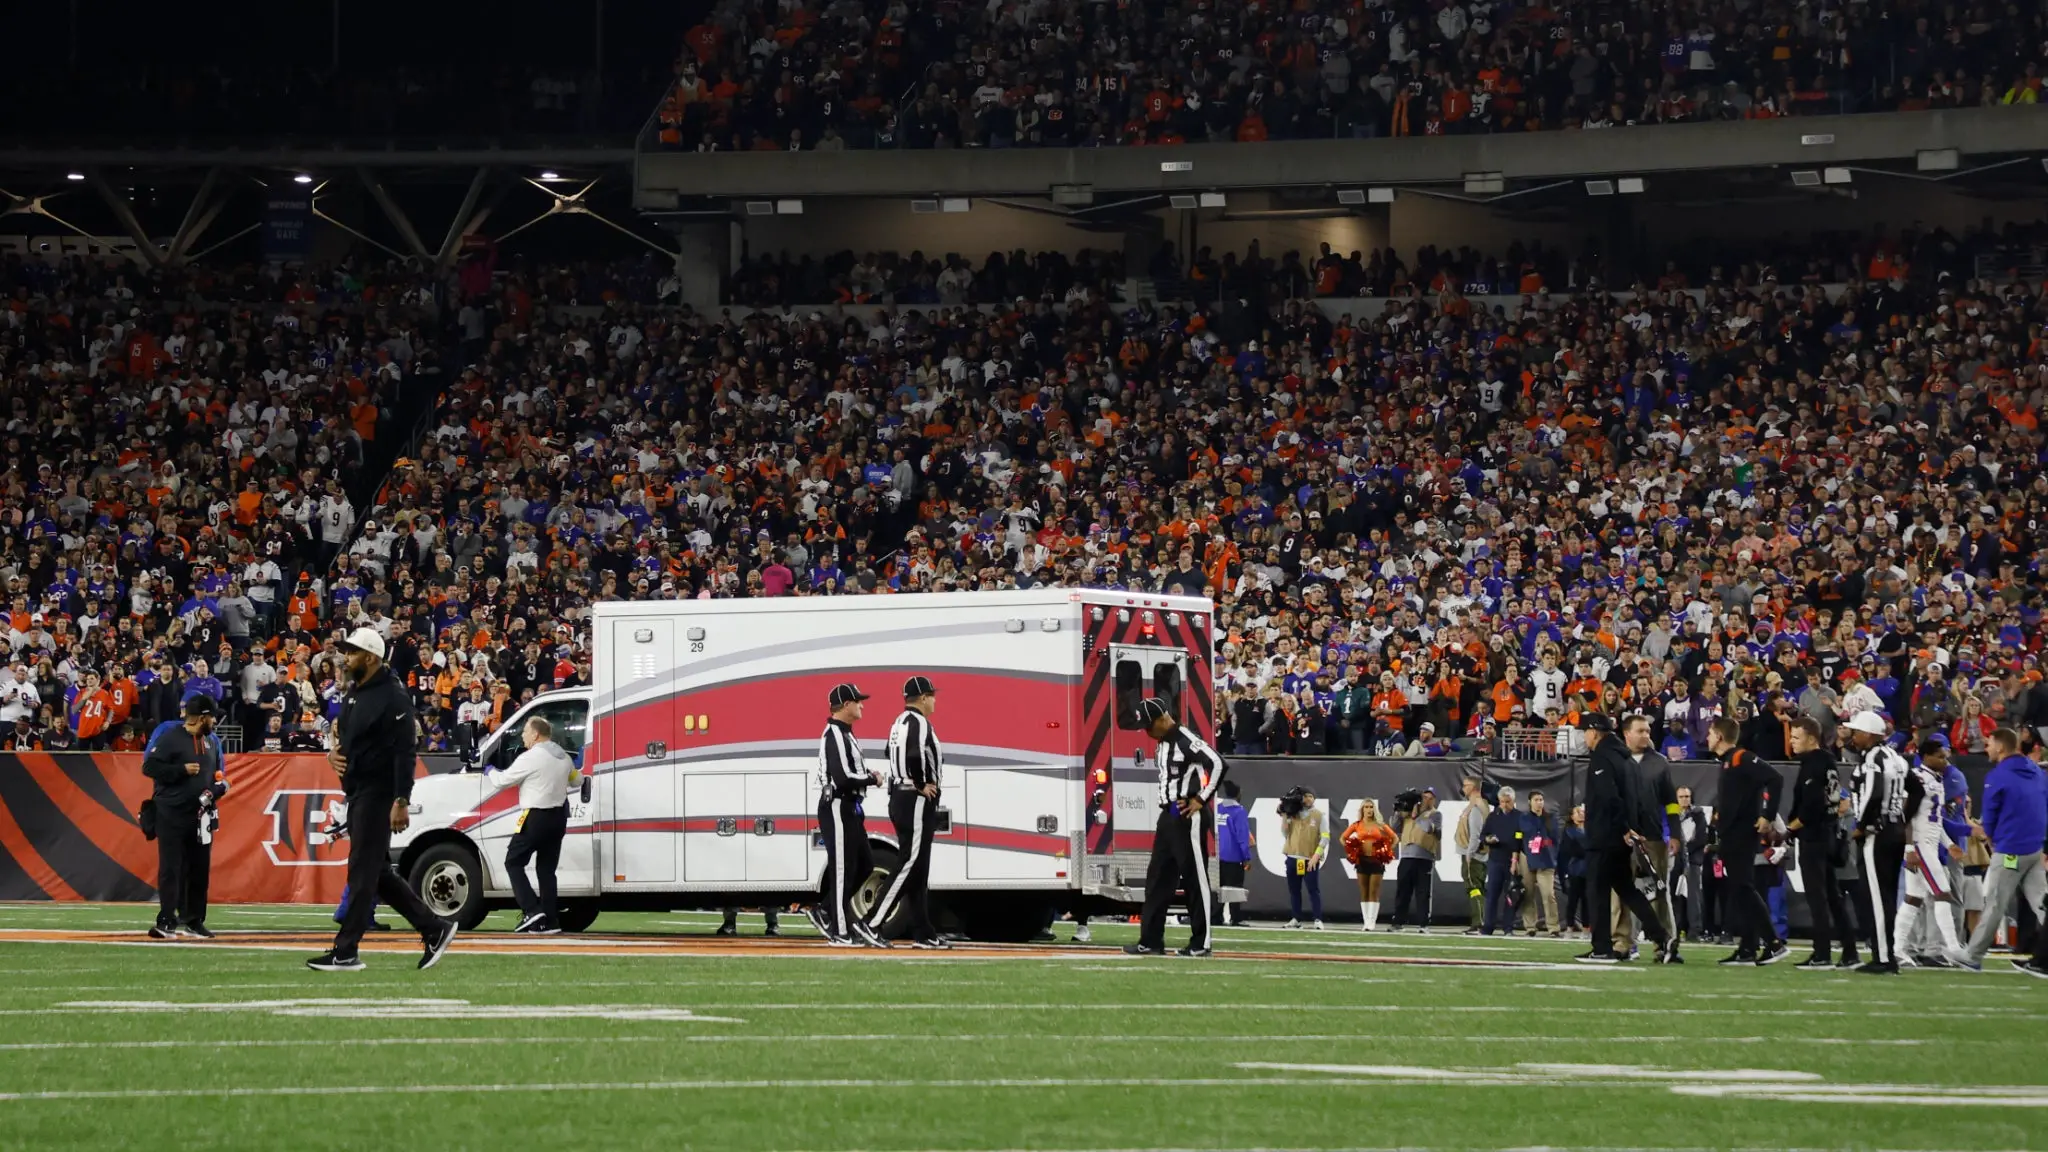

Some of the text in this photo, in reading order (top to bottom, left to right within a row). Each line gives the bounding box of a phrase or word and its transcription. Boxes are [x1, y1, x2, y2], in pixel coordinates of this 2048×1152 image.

[1381, 10, 1396, 24] 17
[702, 33, 715, 44] 55
[1668, 44, 1684, 56] 88
[782, 56, 790, 68] 9
[1104, 77, 1117, 91] 15
[823, 102, 832, 116] 9
[1154, 98, 1162, 111] 9
[1318, 270, 1325, 286] 9
[1876, 296, 1882, 311] 1
[19, 334, 26, 348] 9
[312, 354, 326, 370] 40
[1485, 388, 1494, 404] 9
[789, 409, 796, 422] 9
[1433, 410, 1441, 424] 7
[332, 468, 339, 481] 9
[943, 462, 951, 477] 7
[1032, 500, 1040, 514] 9
[332, 512, 340, 527] 9
[722, 512, 730, 524] 9
[1019, 518, 1026, 533] 9
[1284, 536, 1293, 554] 9
[298, 600, 306, 614] 9
[1672, 620, 1682, 635] 7
[202, 628, 210, 642] 9
[691, 642, 704, 654] 29
[1727, 643, 1736, 662] 9
[528, 664, 536, 681] 9
[114, 690, 122, 705] 9
[1546, 682, 1556, 700] 9
[86, 700, 102, 718] 24
[1342, 696, 1350, 714] 1
[1126, 796, 1146, 809] Health
